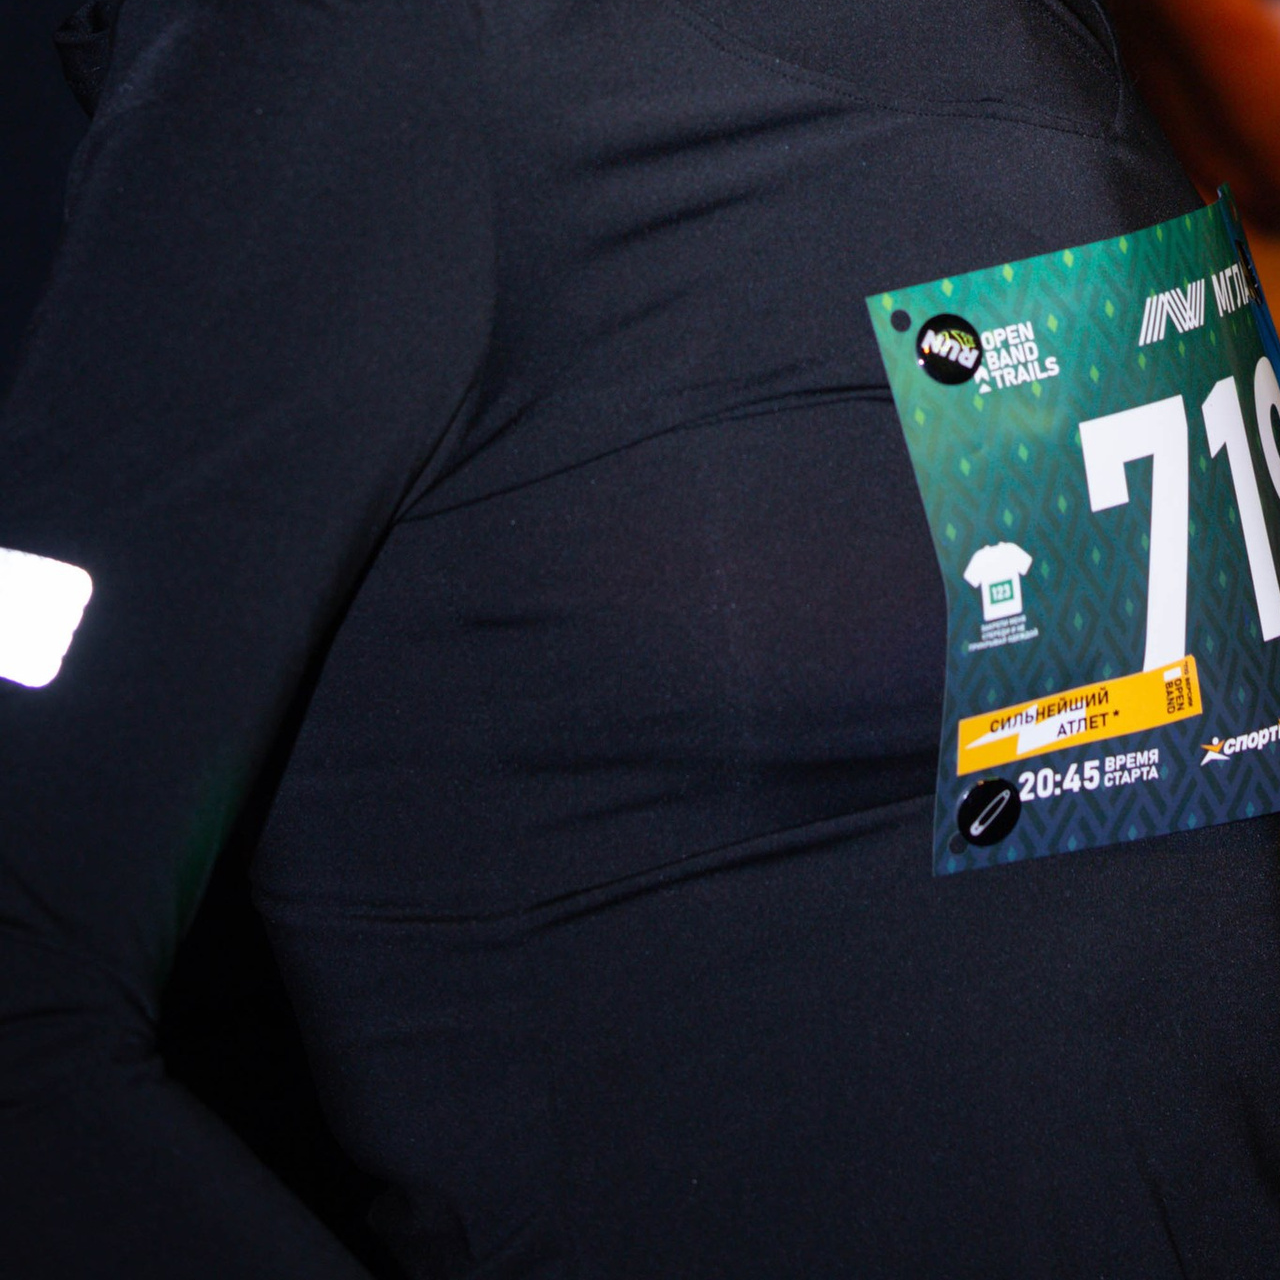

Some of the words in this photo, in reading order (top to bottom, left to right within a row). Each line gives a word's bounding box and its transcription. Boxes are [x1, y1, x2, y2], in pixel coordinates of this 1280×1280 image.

[921, 329, 979, 369] RUN
[980, 321, 1035, 350] OPEN
[985, 341, 1039, 371] BAND
[990, 356, 1060, 389] TRAILS
[991, 583, 1012, 602] 123
[990, 686, 1109, 733] СИЛЬНЕЙШИЙ
[1165, 681, 1176, 714] BAND
[1174, 678, 1185, 712] OPEN
[1105, 748, 1159, 772] ВРЕМЯ
[1018, 759, 1100, 802] 20:45
[1104, 767, 1160, 787] СТАРТА
